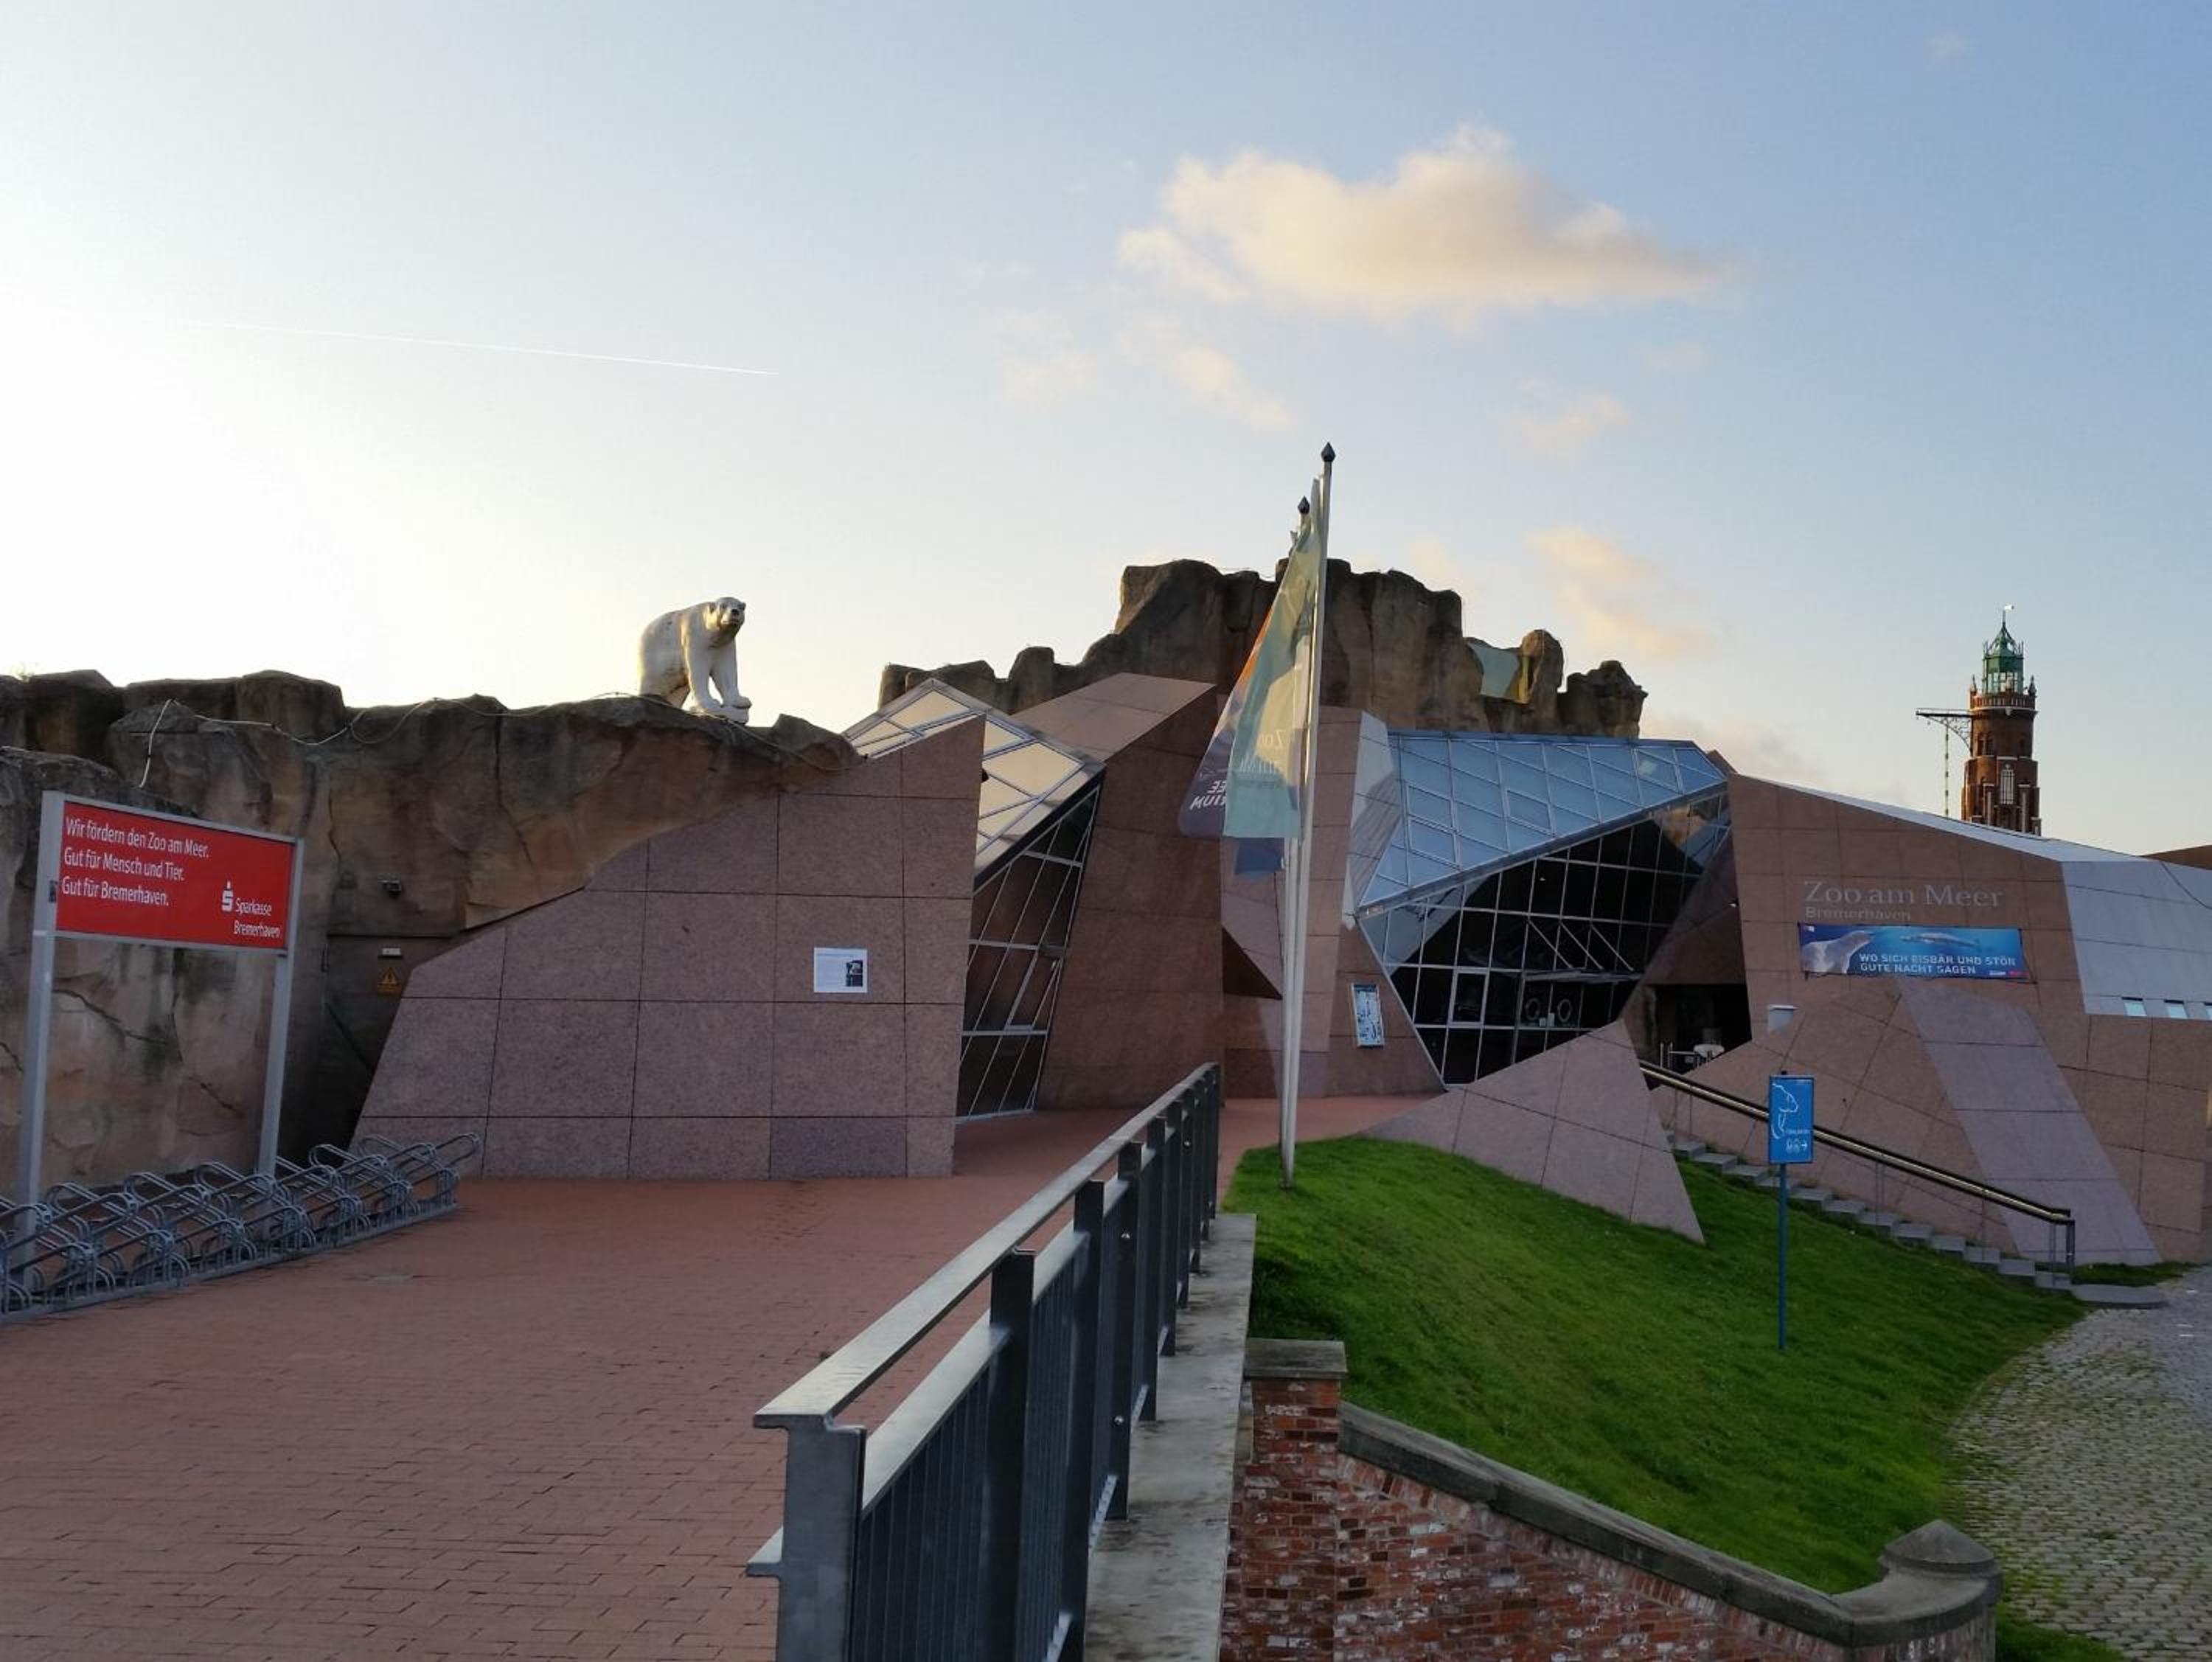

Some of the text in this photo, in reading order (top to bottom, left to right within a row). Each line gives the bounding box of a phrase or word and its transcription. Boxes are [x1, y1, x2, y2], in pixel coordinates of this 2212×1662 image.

[66, 816, 210, 858] Wir fördern den Zoo am Meer.
[64, 848, 185, 882] Gut für Mensch und Tier.
[62, 876, 170, 907] Gut für Bremerhaven.
[1805, 880, 2005, 908] Zoo am Meer
[235, 897, 272, 917] Sparkasse
[1804, 906, 1911, 921] Bremerhaven
[233, 919, 280, 939] Bremerhaven
[1859, 953, 1878, 962] WO
[1880, 954, 1907, 963] SICH
[1957, 956, 1982, 965] UND
[1860, 963, 1890, 972] GUTE
[1893, 964, 1933, 974] NACHT
[1936, 964, 1977, 975] SAGEN
